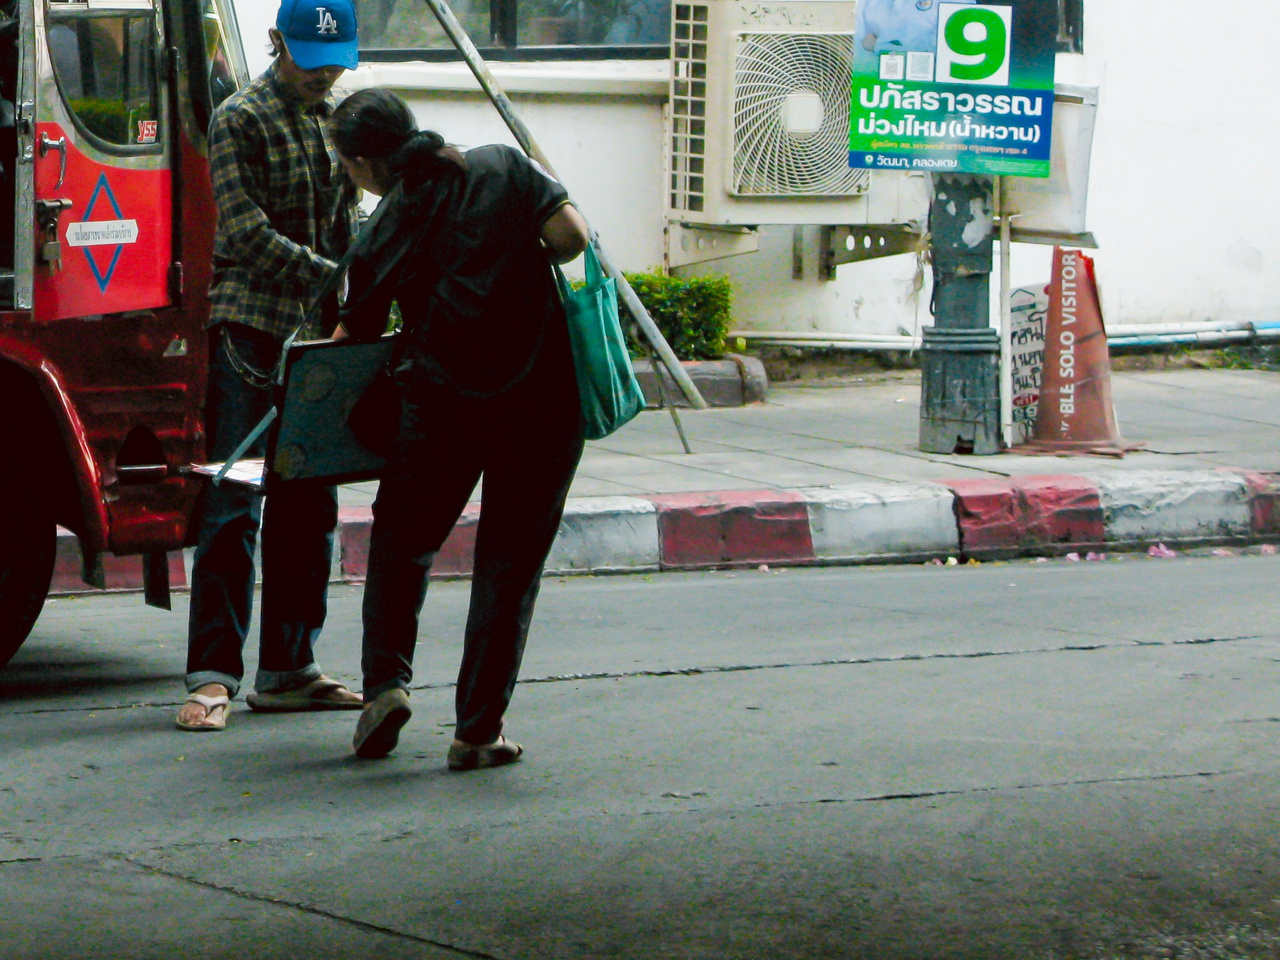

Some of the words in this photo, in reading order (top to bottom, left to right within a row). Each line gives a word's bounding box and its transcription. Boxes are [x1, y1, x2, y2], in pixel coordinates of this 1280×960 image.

[316, 7, 338, 34] LA
[943, 8, 1008, 81] 9
[859, 82, 1043, 116] ปภัสราวรรณ
[1059, 253, 1078, 324] VISITOR
[1059, 330, 1076, 377] SOLO
